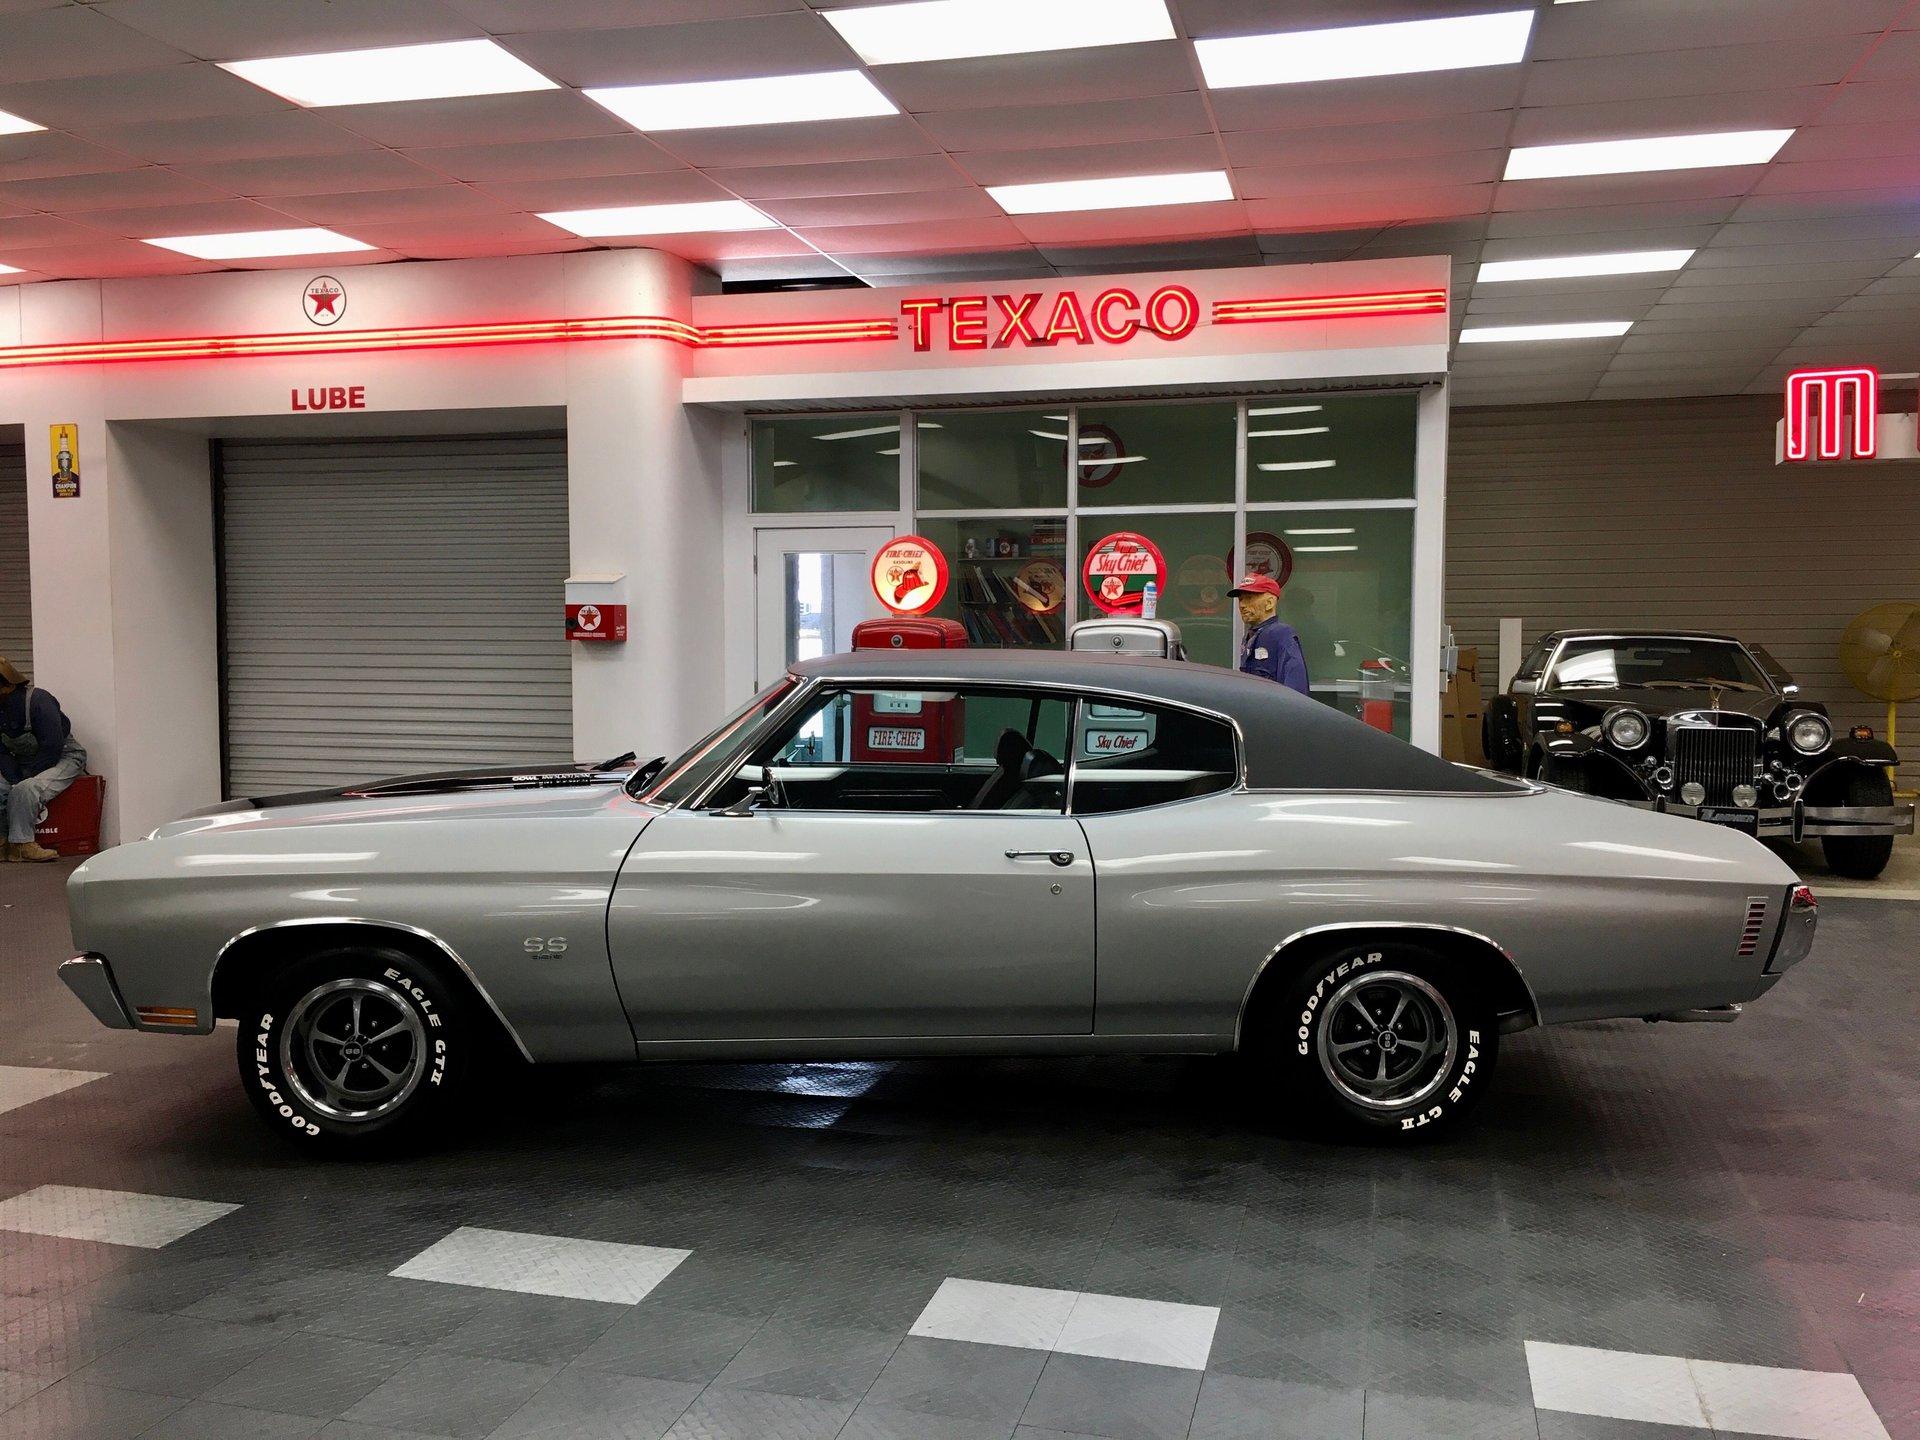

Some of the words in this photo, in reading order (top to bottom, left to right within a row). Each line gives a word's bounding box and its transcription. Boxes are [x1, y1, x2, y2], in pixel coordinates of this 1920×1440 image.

[901, 285, 1199, 352] TEXACO
[291, 385, 366, 411] LUBE
[1783, 365, 1920, 461] M
[1096, 554, 1117, 573] Sky
[1117, 554, 1149, 572] Chief
[1095, 734, 1112, 750] Sky
[1113, 735, 1139, 749] Chief
[523, 936, 568, 952] SS
[384, 967, 442, 1027] EAGLE
[1298, 952, 1383, 1055] GOODYEAR
[256, 1013, 321, 1136] GOODYEAR
[1448, 1030, 1481, 1103] EAGLE
